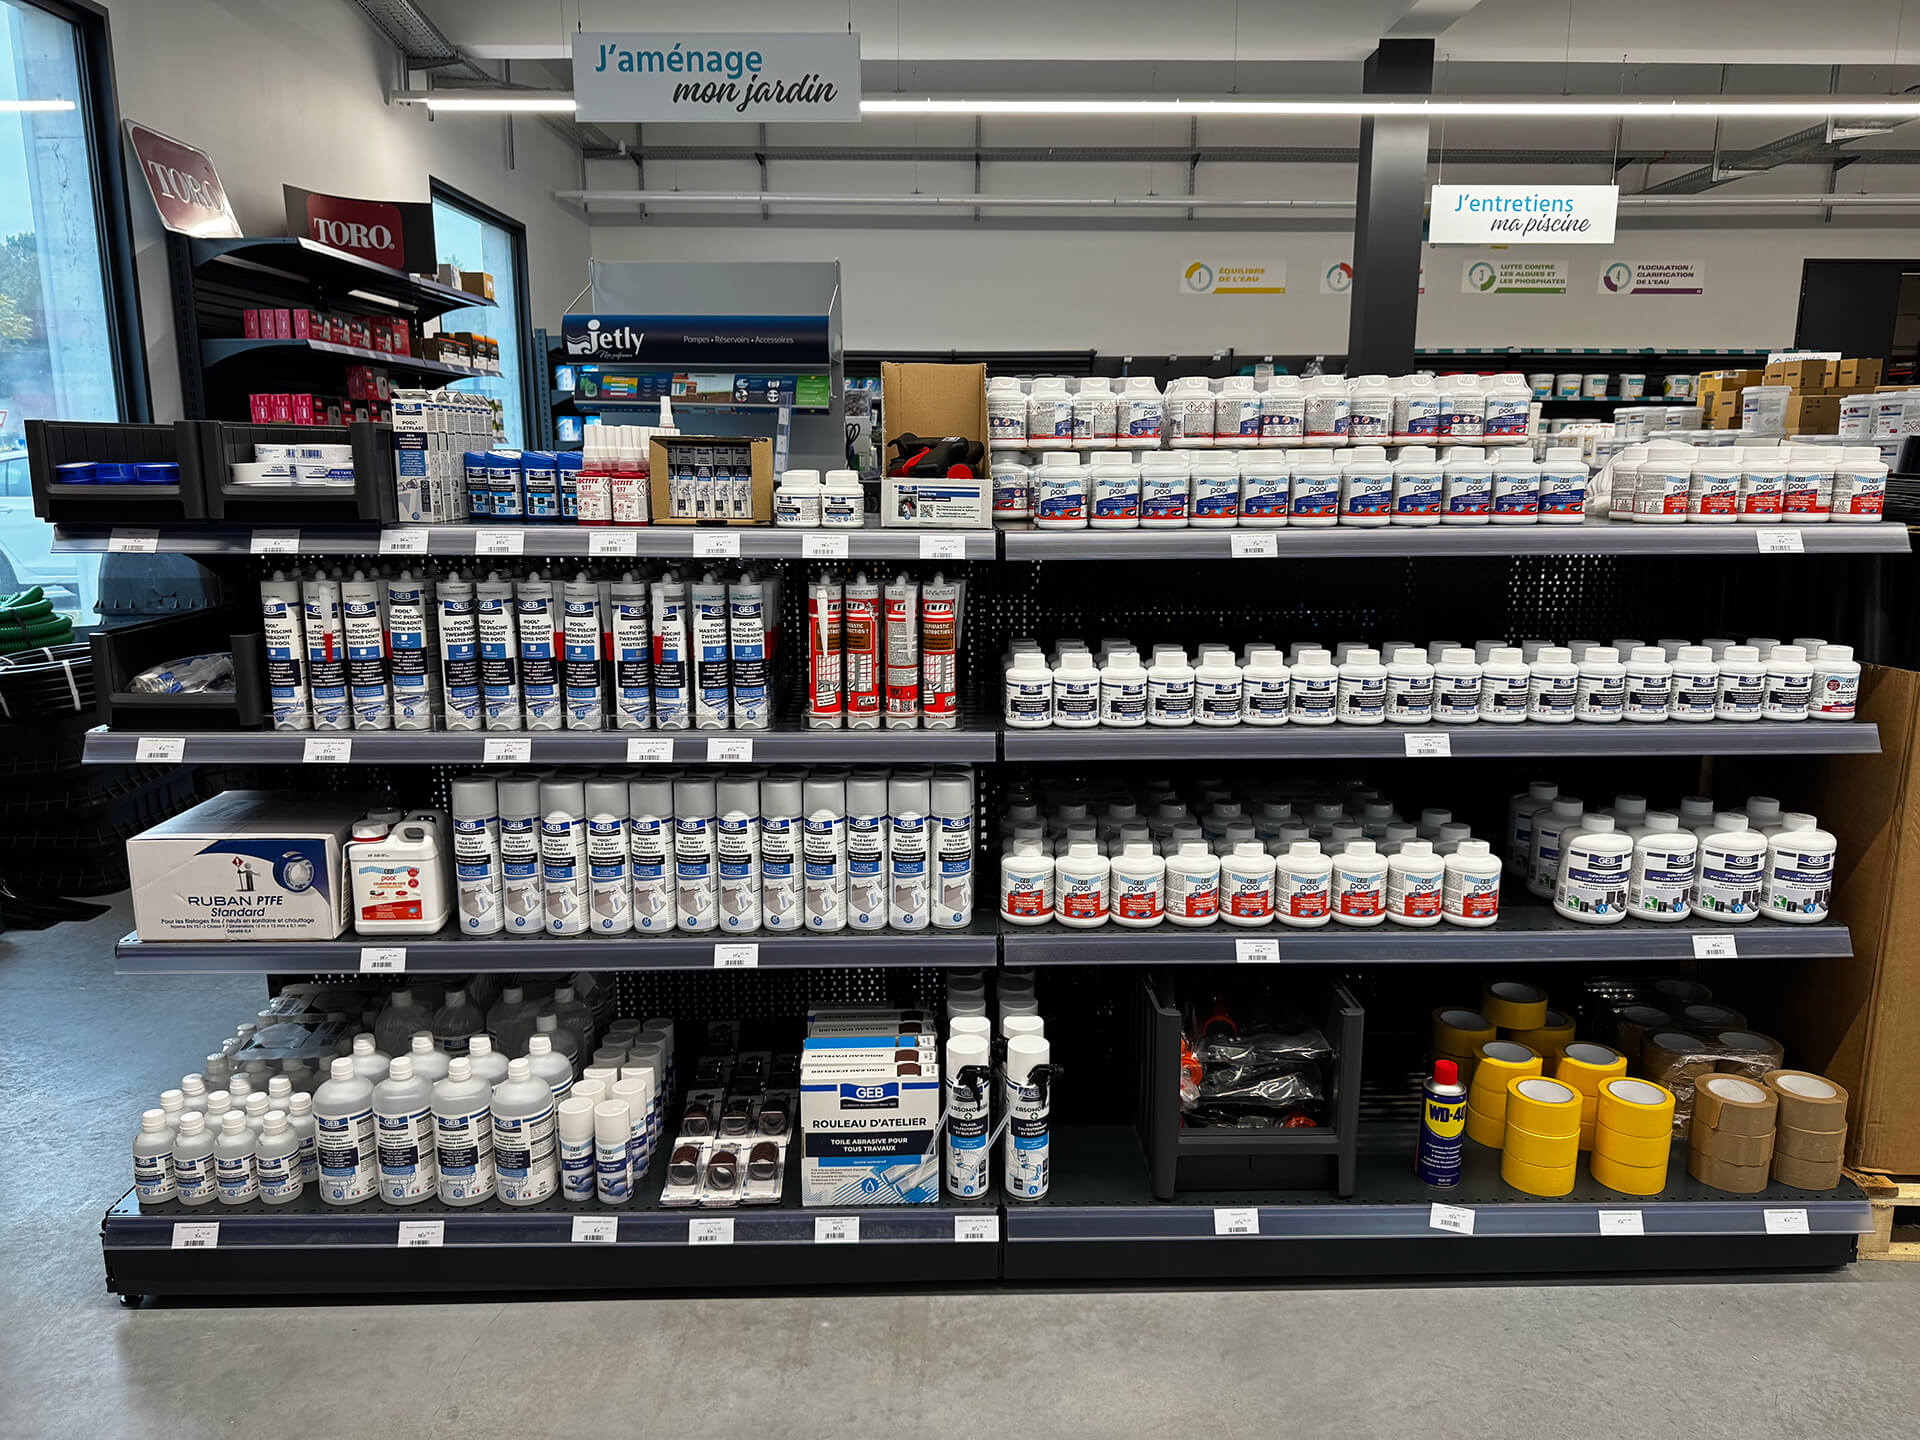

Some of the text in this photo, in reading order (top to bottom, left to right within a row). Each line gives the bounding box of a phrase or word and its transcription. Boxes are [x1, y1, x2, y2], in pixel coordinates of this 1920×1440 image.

[595, 43, 763, 79] J'aménage
[672, 73, 838, 112] mon jardin
[147, 160, 225, 212] TORO
[1454, 193, 1574, 212] J'entretiens
[1490, 213, 1592, 237] ma piscine
[1218, 266, 1265, 275] ÉQUILIBRE
[1218, 275, 1259, 283] DE L'EAU
[1336, 271, 1342, 284] 2
[1478, 269, 1484, 282] 3
[1616, 270, 1621, 282] 4
[584, 318, 644, 356] jetly
[683, 334, 794, 346] Pompes Réservoirs Accessoires
[1710, 484, 1730, 492] pool
[1756, 483, 1774, 492] pool
[1788, 482, 1807, 491] pool
[1862, 483, 1879, 492] pool
[394, 592, 412, 600] GEB
[350, 604, 368, 612] GEB
[452, 602, 469, 610] GEB
[568, 604, 586, 612] GEB
[628, 606, 644, 614] GEB
[459, 822, 476, 830] GEB
[506, 821, 524, 830] GEB
[545, 822, 562, 832] GEB
[595, 822, 612, 832] GEB
[636, 822, 652, 830] GEB
[681, 822, 698, 830] GEB
[724, 821, 740, 830] GEB
[766, 821, 782, 830] GEB
[809, 822, 824, 830] GEB
[856, 820, 872, 828] GEB
[900, 820, 916, 830] GEB
[950, 819, 966, 828] GEB
[1808, 856, 1824, 864] GEB
[1014, 882, 1034, 892] pool
[1072, 884, 1092, 893] pool
[1128, 884, 1148, 894] pool
[1194, 884, 1212, 892] pool
[1240, 884, 1260, 892] pool
[1300, 883, 1320, 892] pool
[1350, 882, 1370, 892] pool
[1414, 883, 1434, 892] pool
[1473, 883, 1492, 892] pool
[188, 895, 284, 906] RUBAN PTFE
[210, 907, 266, 918] Standard
[284, 917, 315, 926] chauffage
[856, 1087, 884, 1098] GEB
[812, 1117, 927, 1128] ROULEAU D'ATELIER
